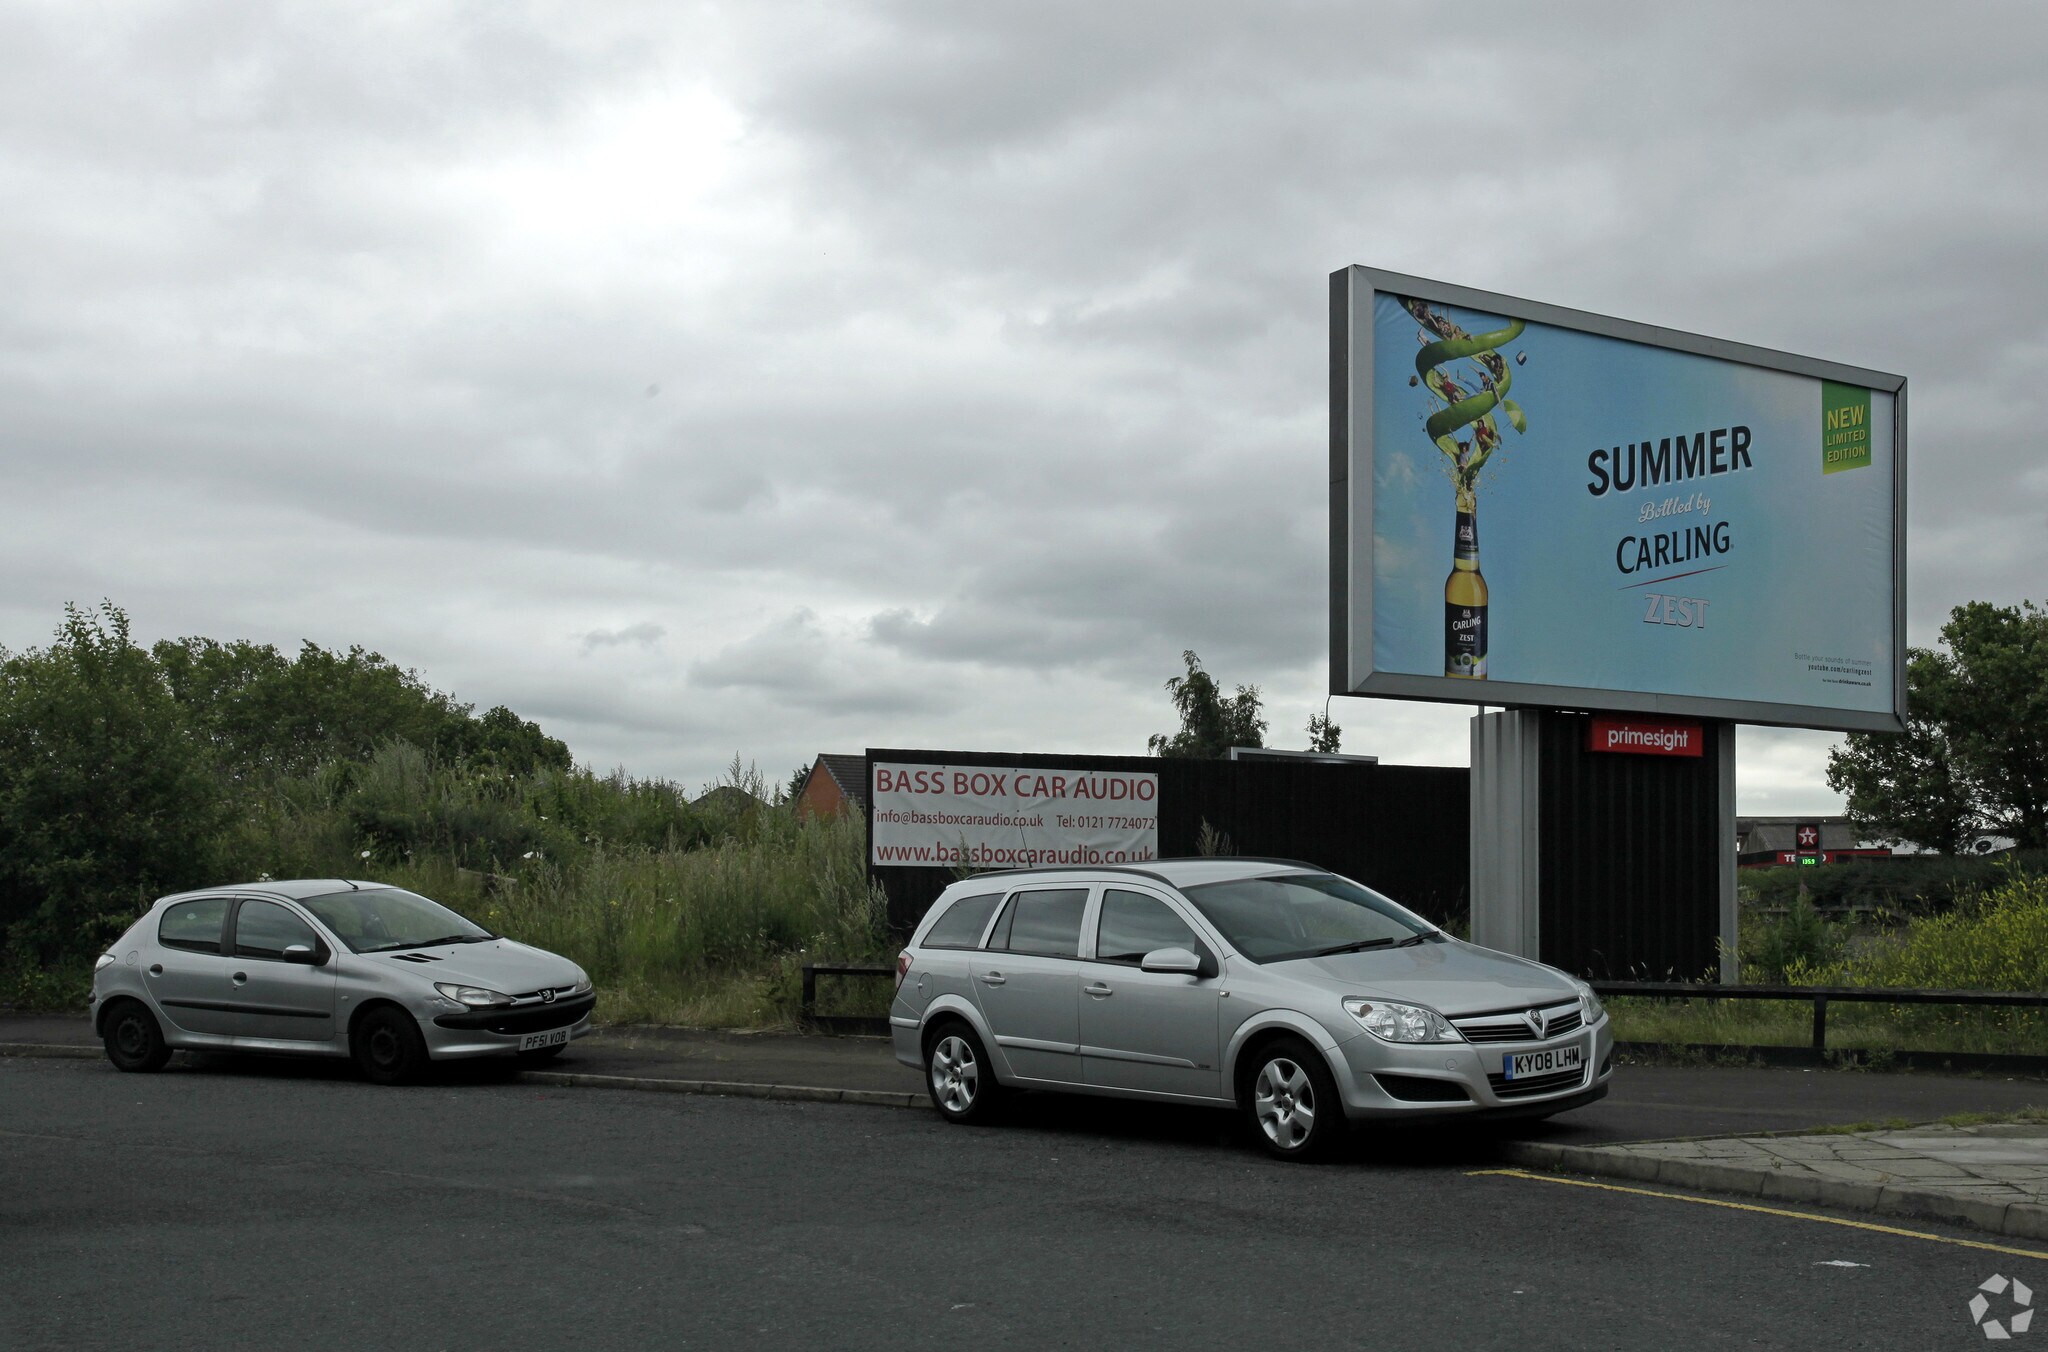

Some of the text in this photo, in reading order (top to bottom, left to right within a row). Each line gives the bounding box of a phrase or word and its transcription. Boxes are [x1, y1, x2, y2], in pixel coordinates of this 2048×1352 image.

[1827, 404, 1865, 431] NEW
[1827, 430, 1866, 447] LIMITED
[1587, 425, 1753, 497] SUMMER
[1827, 445, 1866, 463] EDITION
[1638, 492, 1711, 523] Bottled by
[1616, 521, 1730, 574] CARLING
[1643, 593, 1710, 628] ZEST
[1452, 616, 1481, 631] CARLING
[1808, 664, 1872, 676] youtube.com/carlingzest
[1608, 726, 1688, 751] primesight
[876, 769, 1156, 801] BASS BOX CAR AUDIO
[876, 810, 1155, 830] info@bassboxcaraudio.co.uk Tel: 0121 7724072
[876, 841, 1153, 865] www.bassboxcaraudio.couk
[525, 1030, 567, 1049] PF51 VOB
[1515, 1047, 1580, 1074] KY08 LHM
